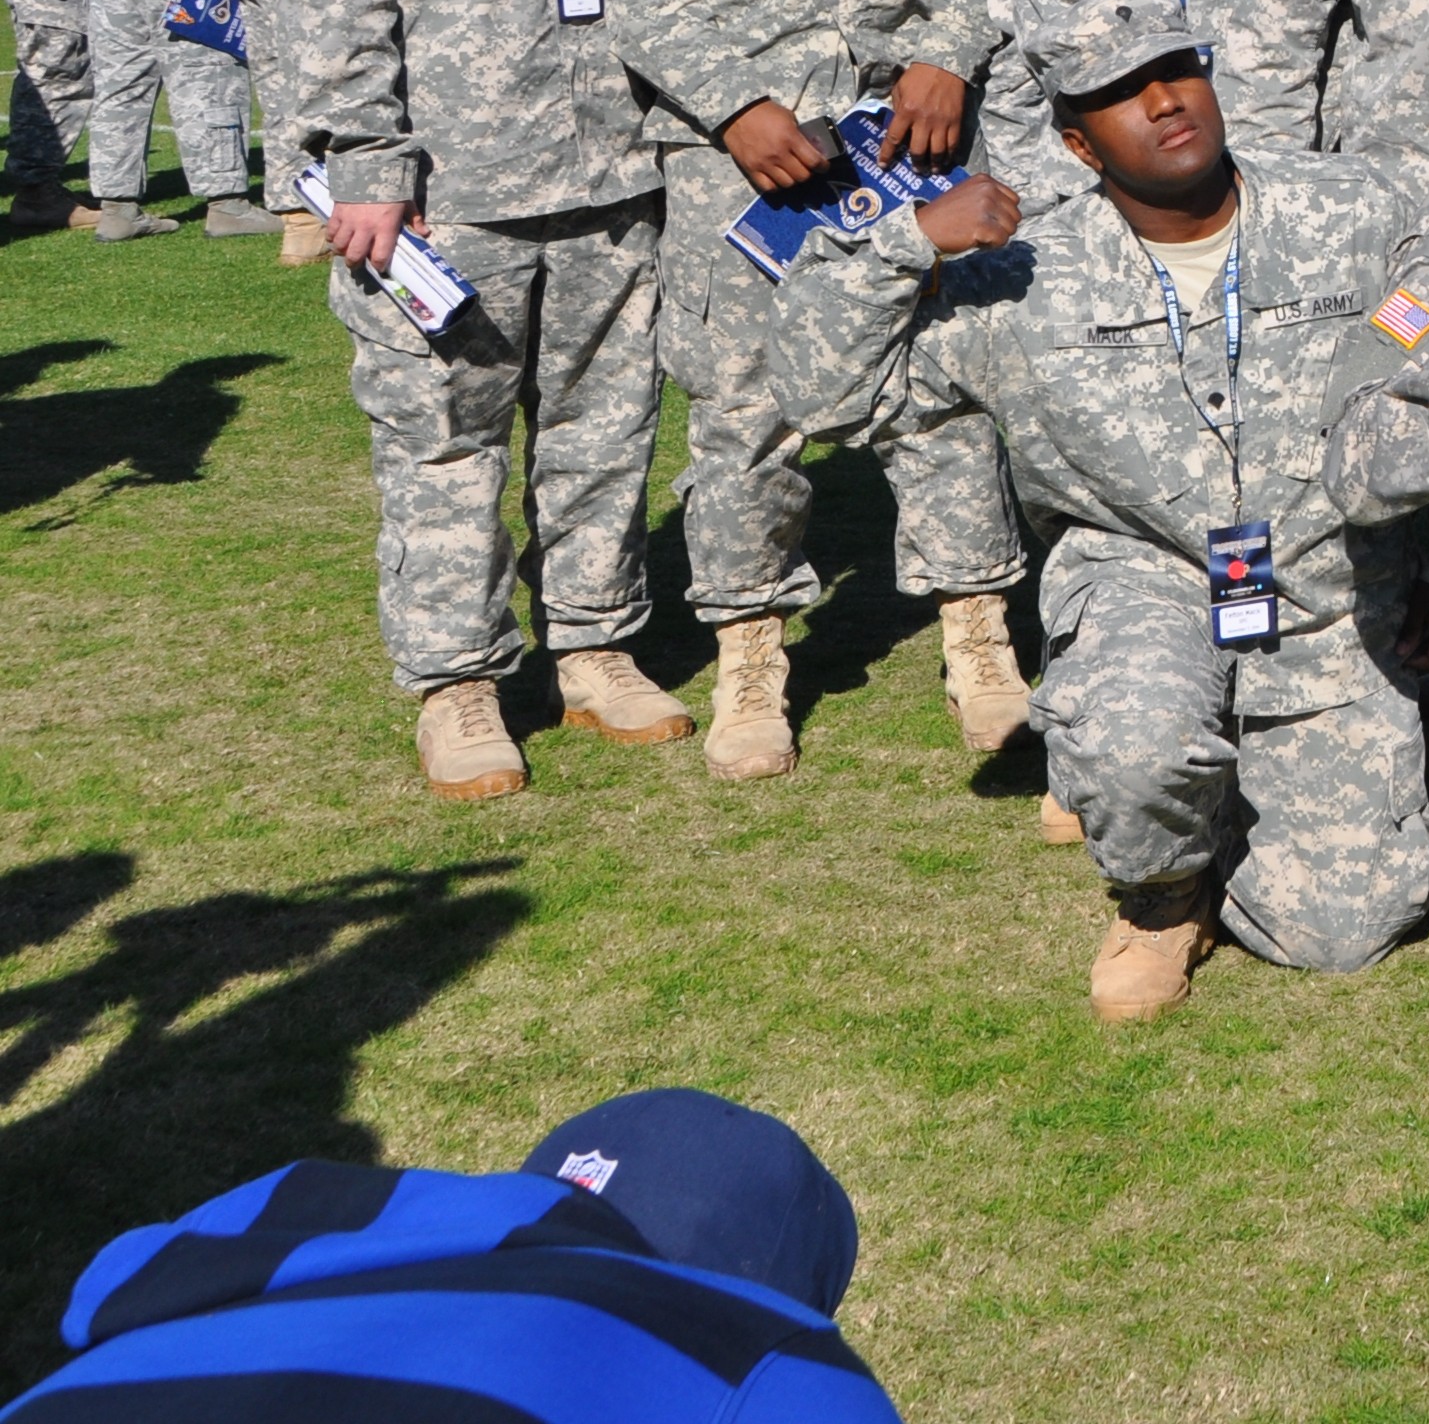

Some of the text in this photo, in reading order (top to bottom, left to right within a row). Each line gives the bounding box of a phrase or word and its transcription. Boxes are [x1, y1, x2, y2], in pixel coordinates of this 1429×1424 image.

[852, 150, 882, 181] YOUR
[1274, 291, 1358, 322] U.S. ARMY
[1087, 326, 1135, 344] MACK
